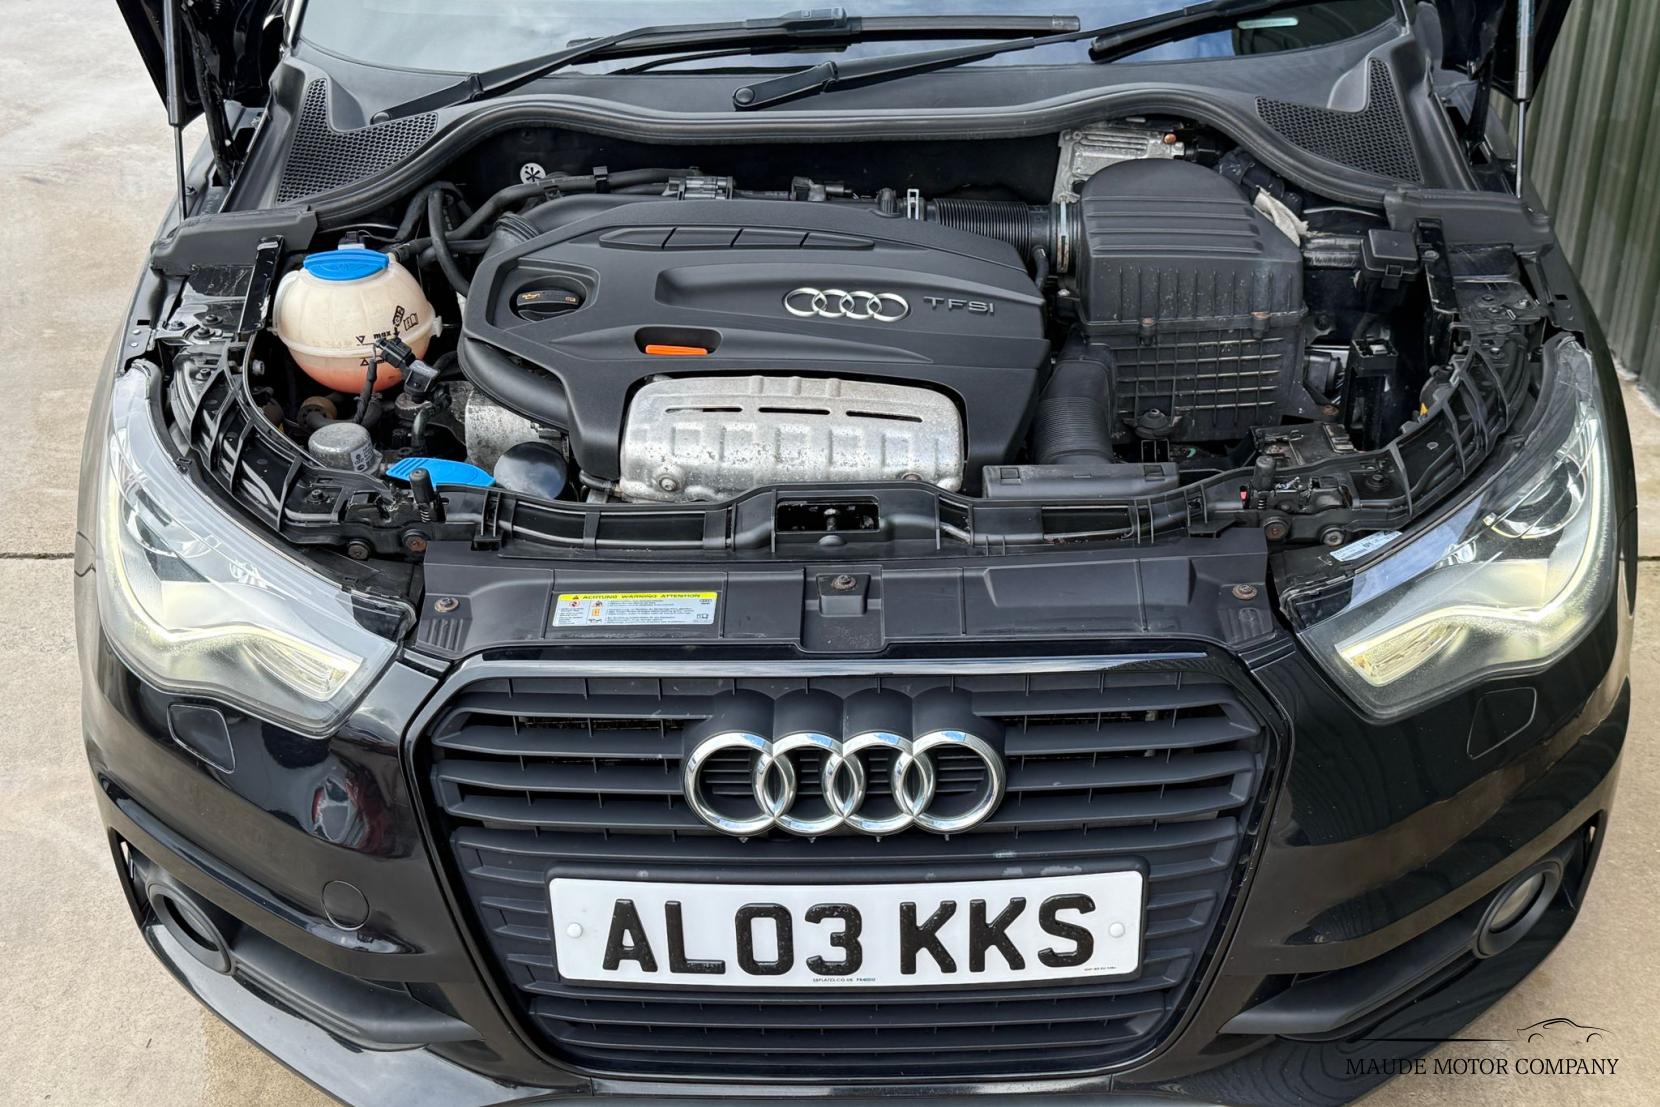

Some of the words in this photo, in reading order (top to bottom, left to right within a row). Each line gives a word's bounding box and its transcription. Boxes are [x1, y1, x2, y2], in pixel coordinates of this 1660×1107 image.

[923, 296, 994, 314] TFSI
[603, 898, 863, 976] AL03
[899, 893, 1096, 975] KKS
